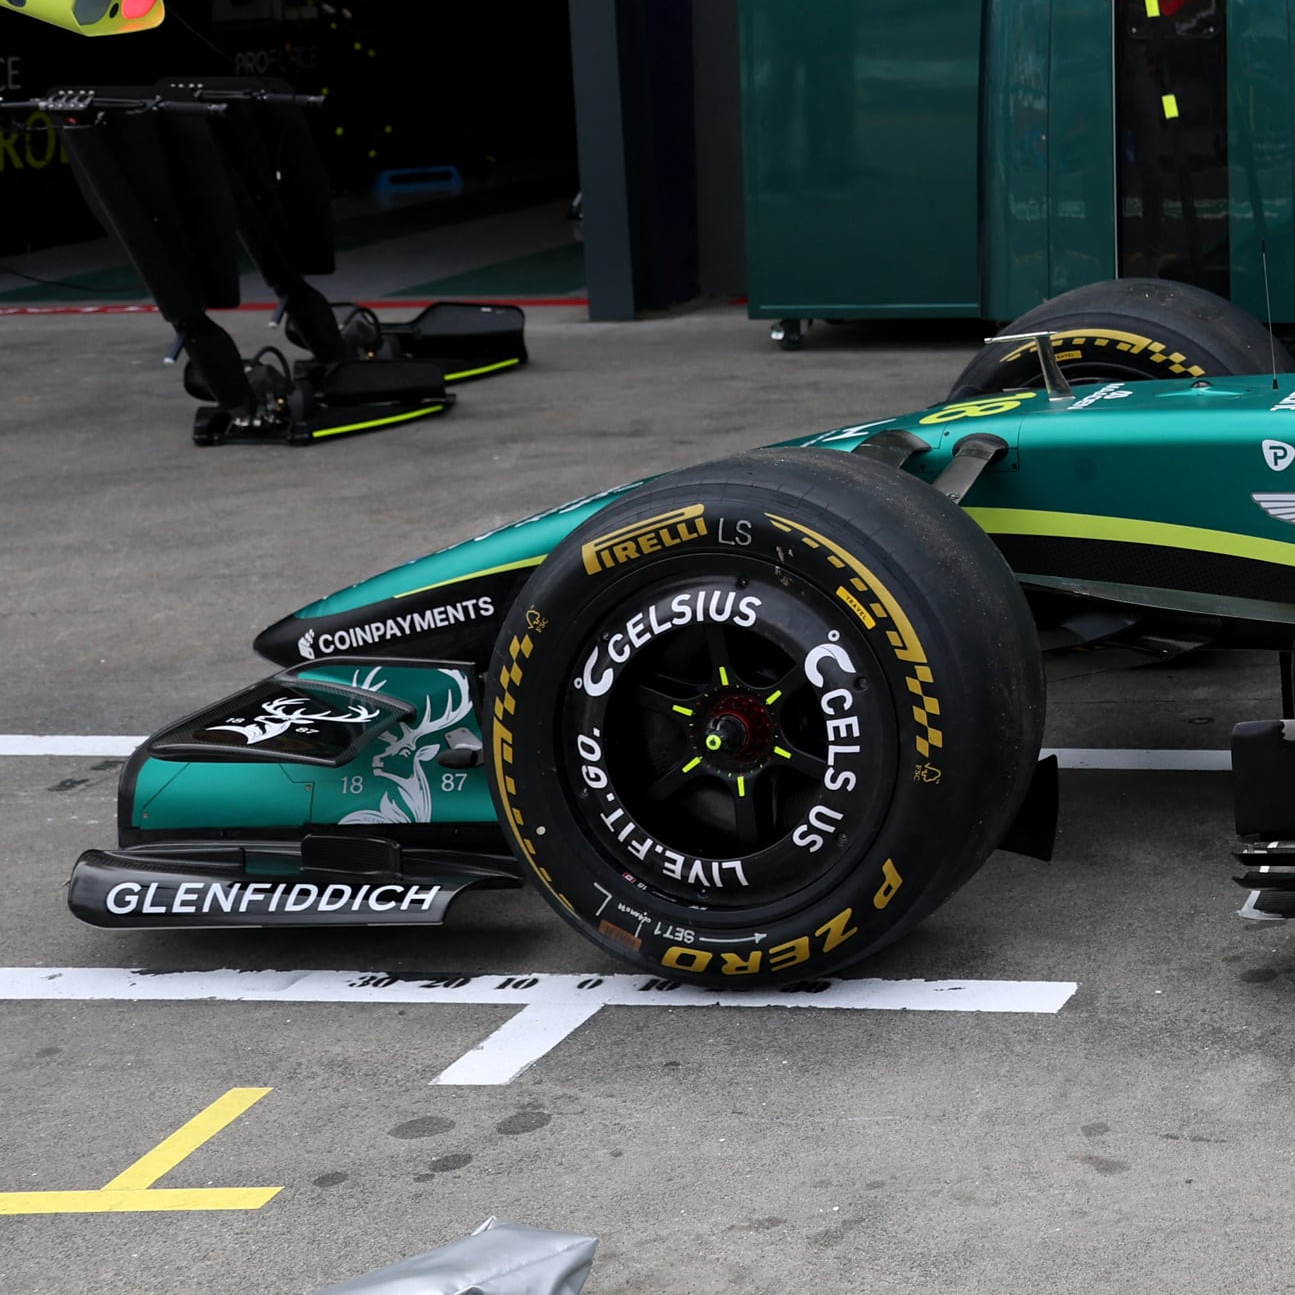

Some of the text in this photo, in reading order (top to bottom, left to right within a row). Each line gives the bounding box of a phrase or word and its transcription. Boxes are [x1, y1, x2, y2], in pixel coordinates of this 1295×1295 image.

[582, 504, 709, 575] PIRELLI
[717, 517, 752, 547] LS
[318, 596, 495, 655] COINPAYMENTS
[607, 590, 762, 663] CELSIUS
[340, 772, 468, 794] 18 87
[793, 686, 863, 854] CELSUS
[105, 881, 444, 914] GLENFIDDICH
[661, 857, 903, 976] P ZERO
[348, 975, 396, 989] 30
[419, 976, 471, 989] 20
[495, 977, 539, 990] 10
[577, 978, 603, 990] 0
